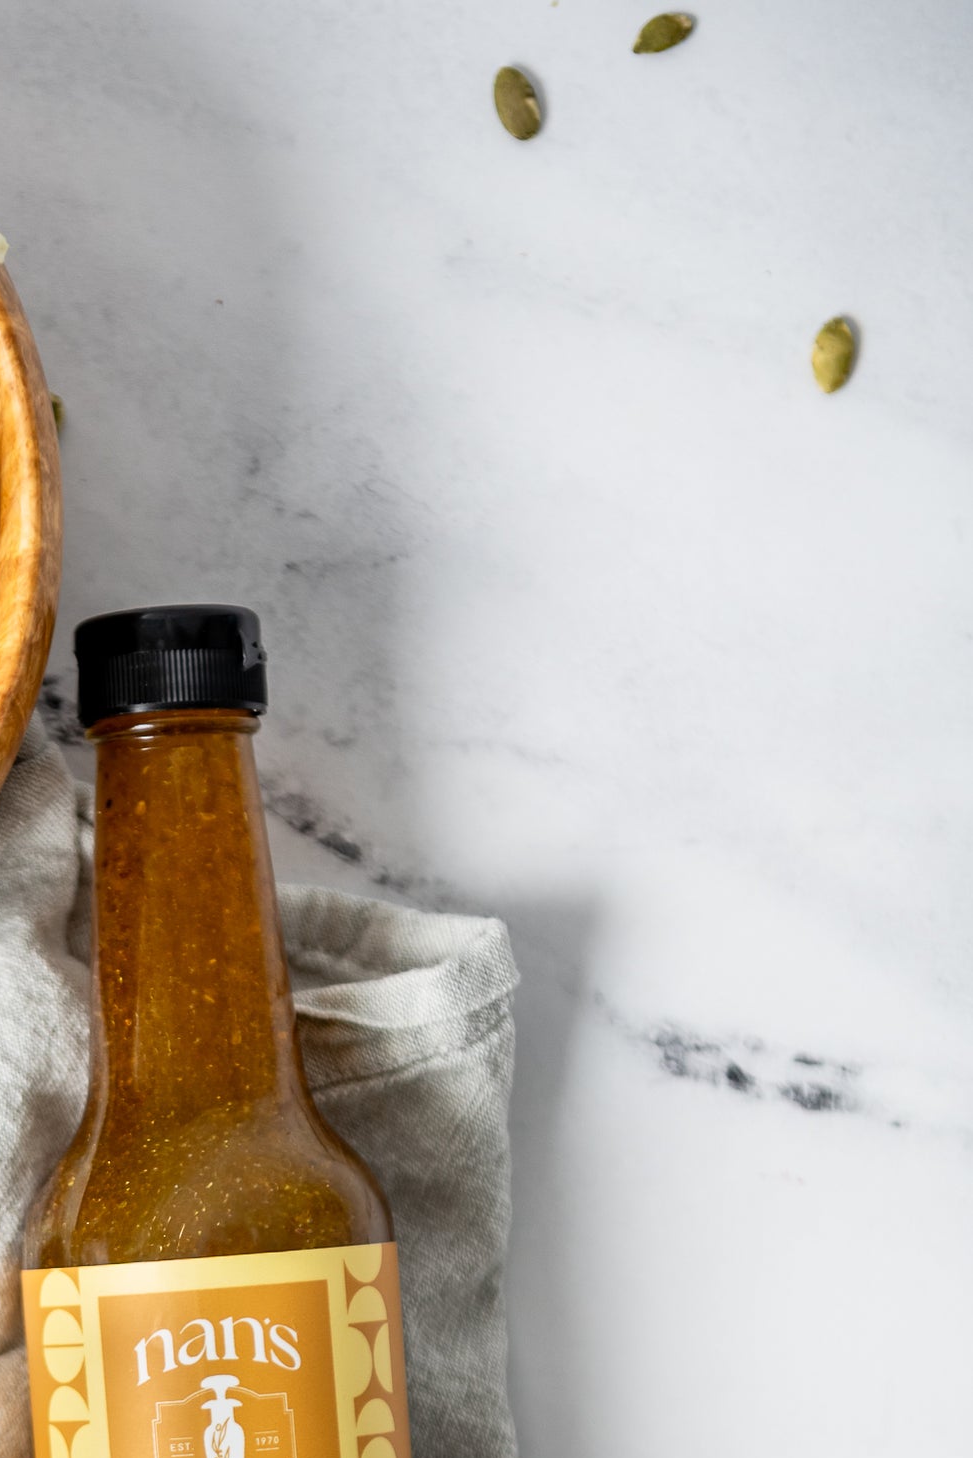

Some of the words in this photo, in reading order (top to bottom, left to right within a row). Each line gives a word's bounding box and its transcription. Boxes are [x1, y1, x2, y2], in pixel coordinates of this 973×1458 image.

[133, 1315, 302, 1387] nan's
[169, 1442, 195, 1452] EST.
[255, 1435, 280, 1446] 1970
